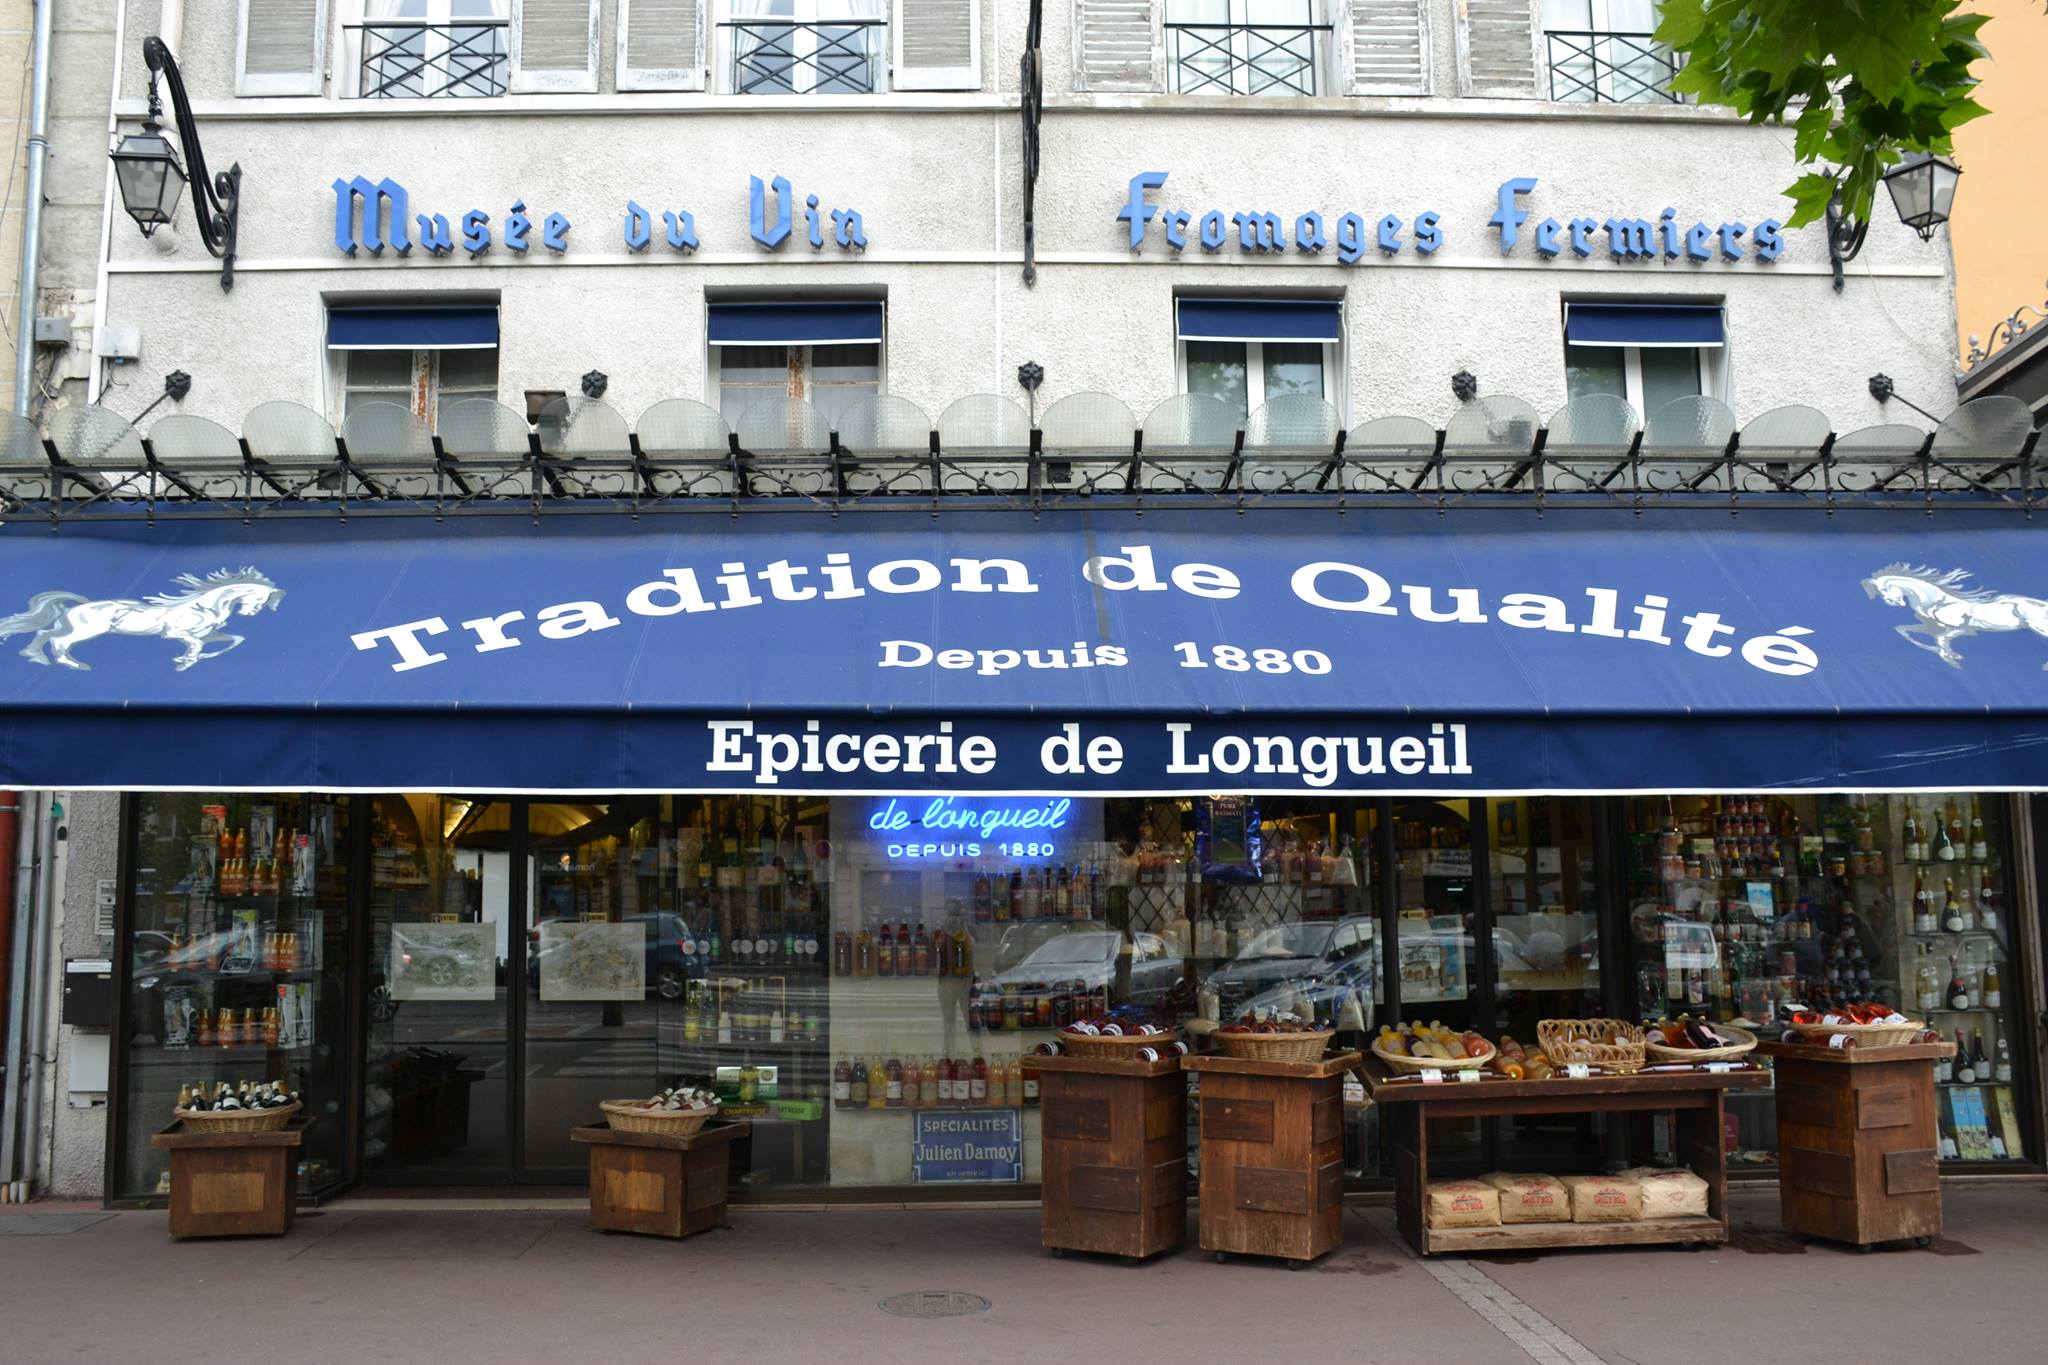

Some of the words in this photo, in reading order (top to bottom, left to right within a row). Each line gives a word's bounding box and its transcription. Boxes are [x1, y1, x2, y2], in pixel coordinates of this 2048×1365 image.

[331, 175, 571, 253] Musée
[625, 201, 700, 249] du
[750, 175, 867, 248] Vin
[1117, 172, 1444, 263] Fromages
[1488, 178, 1785, 259] Fermiers
[351, 552, 1038, 672] Tradition
[1082, 546, 1240, 600] de
[1291, 562, 1819, 676] Qualité
[879, 640, 1128, 676] Depuis
[1174, 642, 1333, 675] 1880
[707, 721, 997, 784] Epicerie
[1041, 724, 1124, 775] de
[1167, 724, 1473, 787] Longueil
[869, 798, 912, 830] de
[887, 843, 981, 858] DEPUIS
[998, 842, 1055, 857] 1880
[916, 1143, 962, 1162] Julien
[964, 1143, 1018, 1163] Damoy
